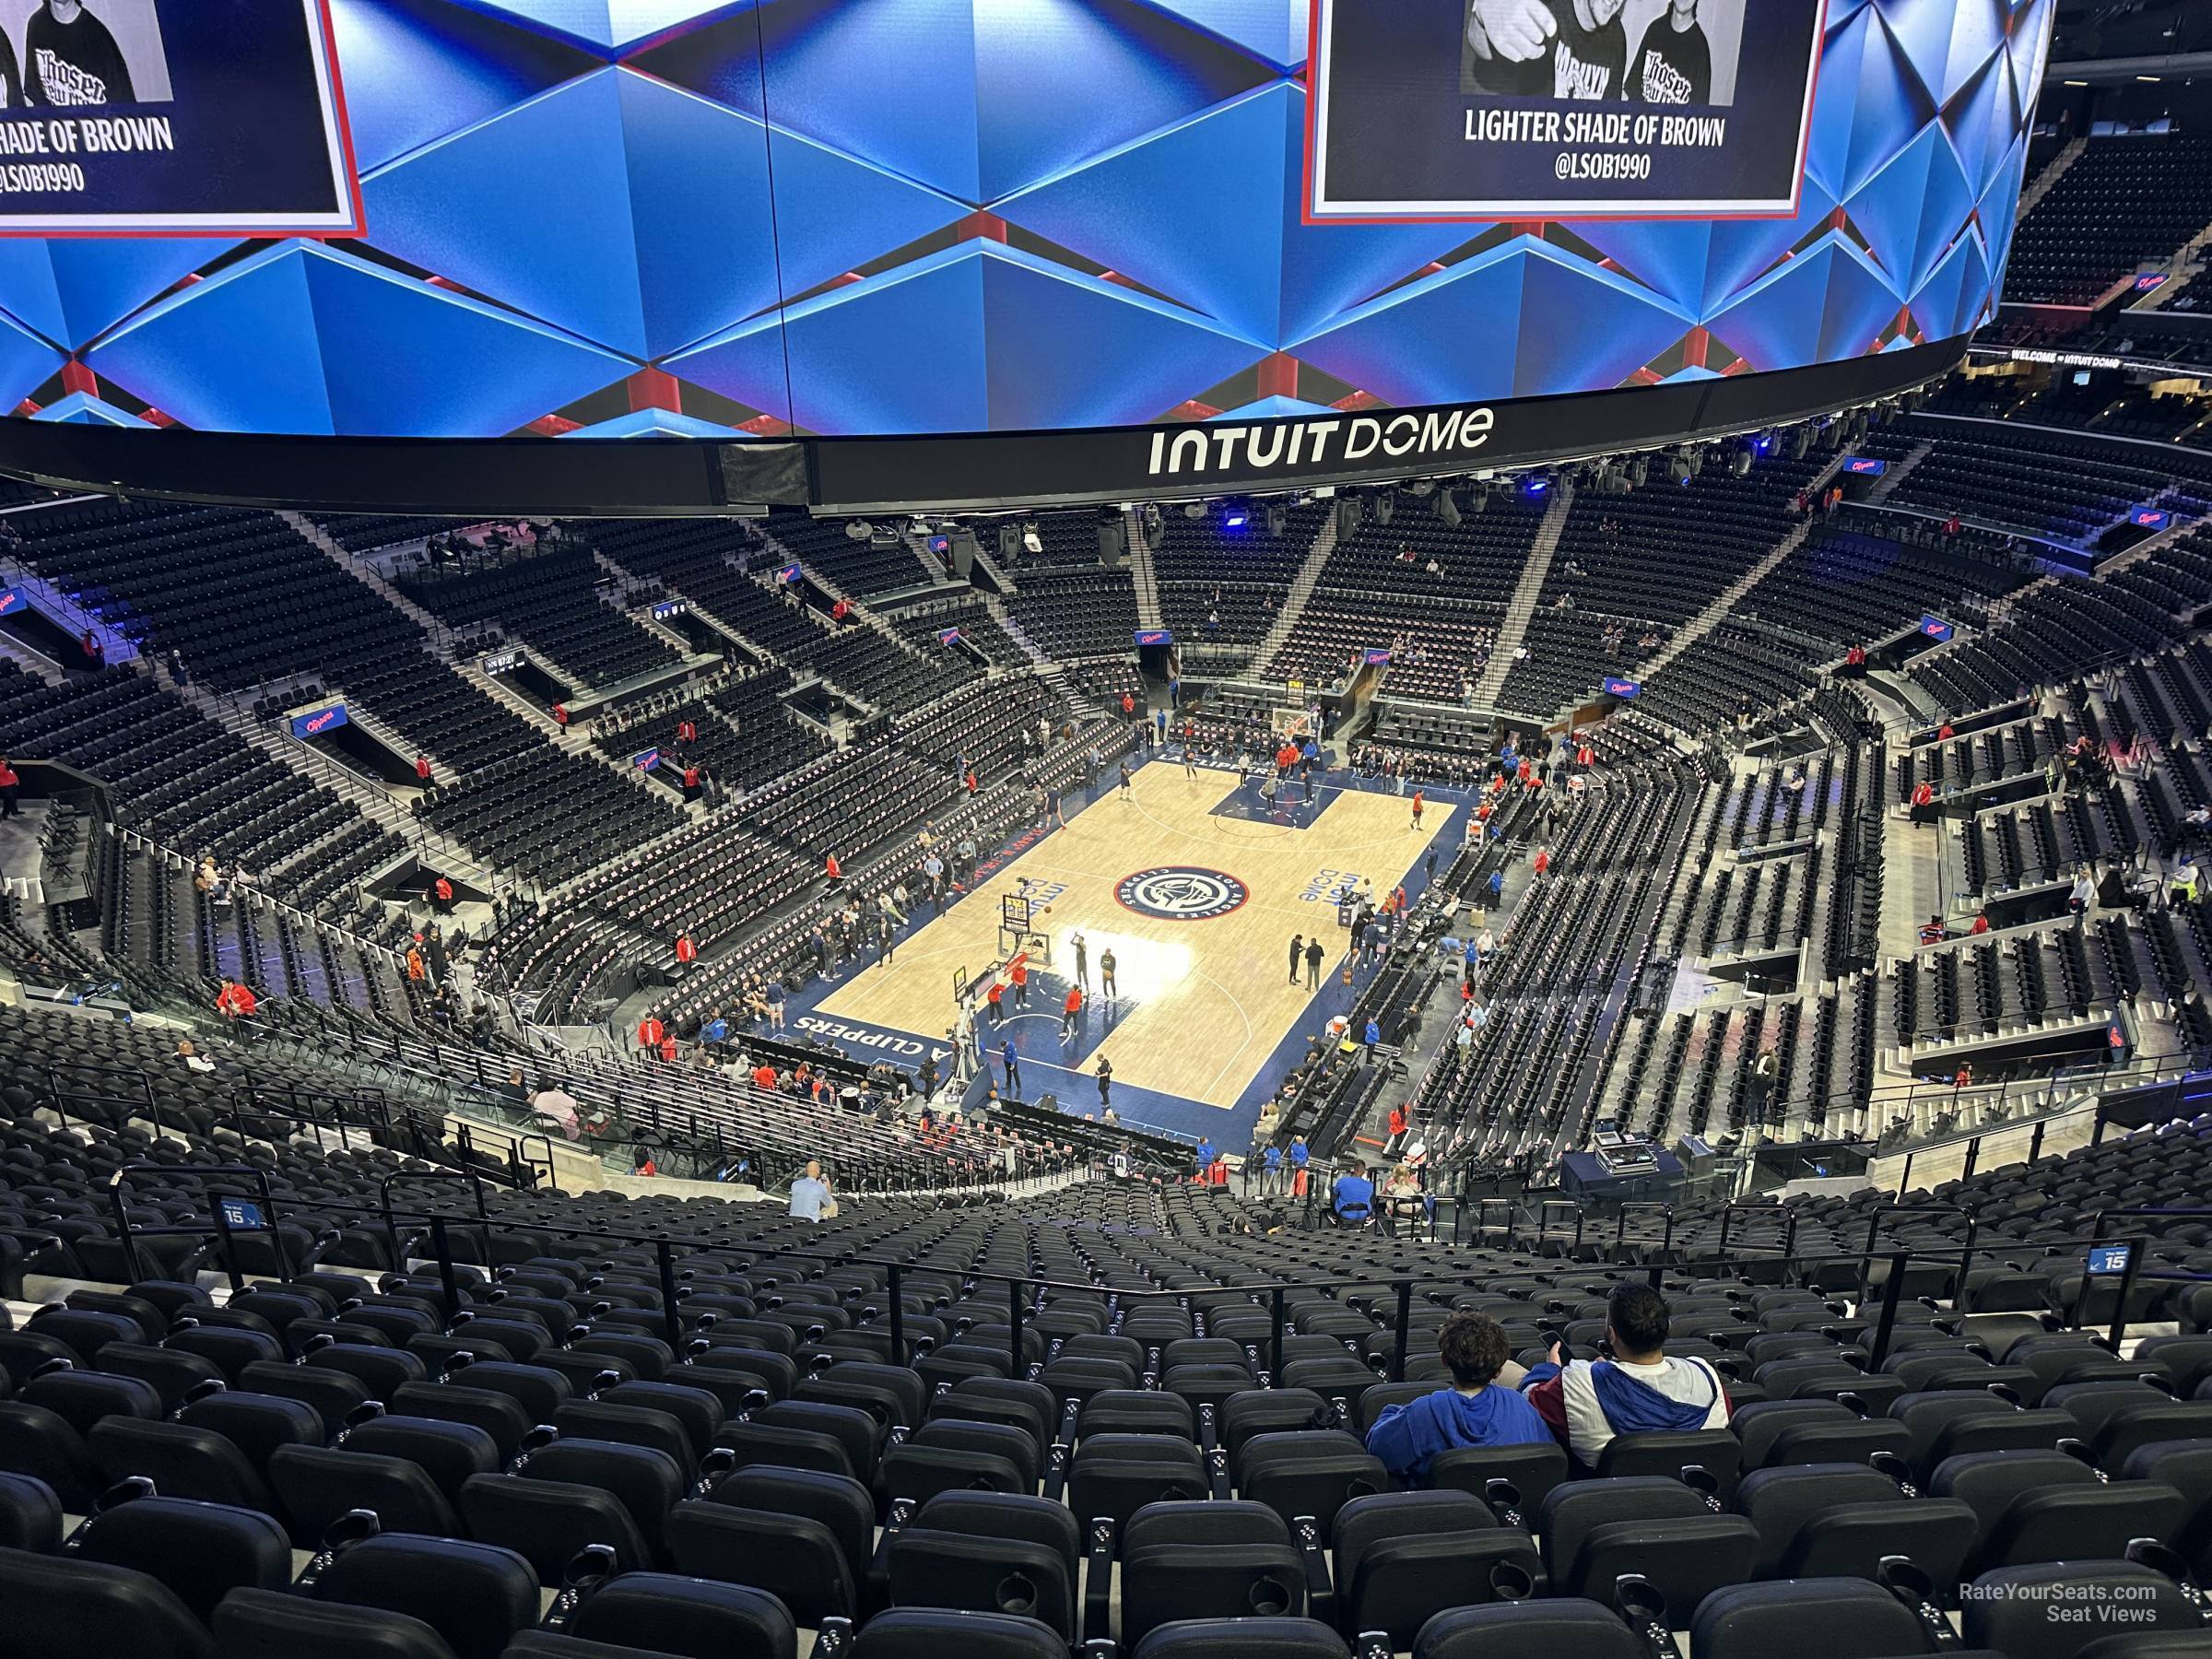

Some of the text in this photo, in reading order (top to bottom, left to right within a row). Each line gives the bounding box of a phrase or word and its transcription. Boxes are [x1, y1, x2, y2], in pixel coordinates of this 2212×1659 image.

[49, 119, 77, 153] OF
[80, 117, 174, 153] BROWN
[1465, 109, 1725, 147] LIGHTER SHADE OF BROWN
[1555, 152, 1651, 180] @LSOB1990
[2011, 349, 2056, 364] WELCOME
[1148, 407, 1495, 475] INTUIT DOME
[1611, 683, 1633, 693] Clippers
[306, 712, 334, 733] Clippers
[1120, 868, 1170, 906] CLIPPERS
[793, 1017, 924, 1055] CLIPPERS
[225, 1210, 244, 1224] 15
[2105, 1255, 2125, 1269] 15
